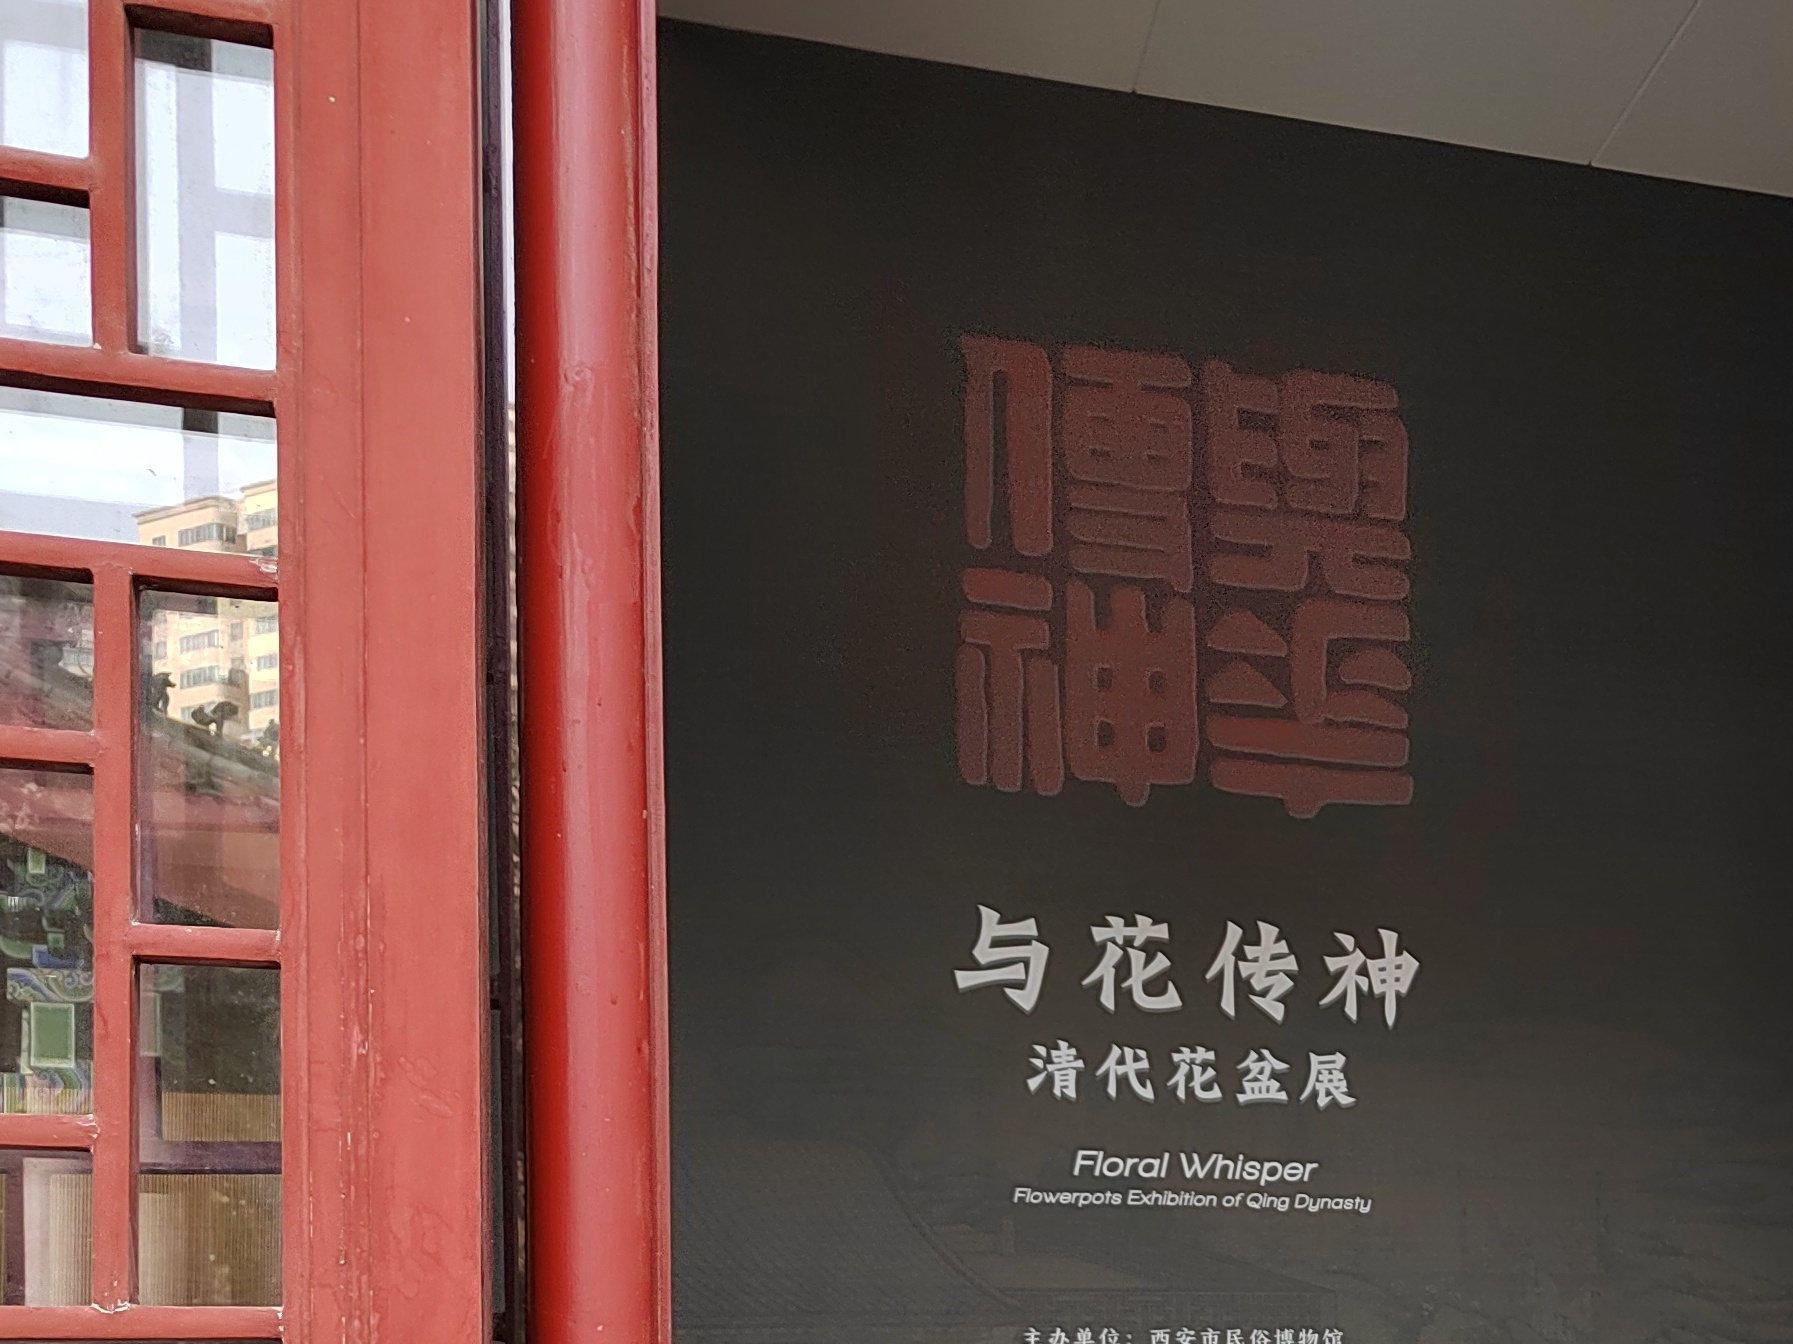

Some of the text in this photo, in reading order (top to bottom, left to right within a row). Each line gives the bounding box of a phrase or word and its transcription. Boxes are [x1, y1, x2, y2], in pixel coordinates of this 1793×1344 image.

[953, 904, 1420, 1029] 与花传神
[1026, 1039, 1357, 1109] 清代花盆展
[1073, 1150, 1318, 1186] Floral Whisper
[1013, 1188, 1372, 1213] Flowerpots Exhibition of Qing Dynasty
